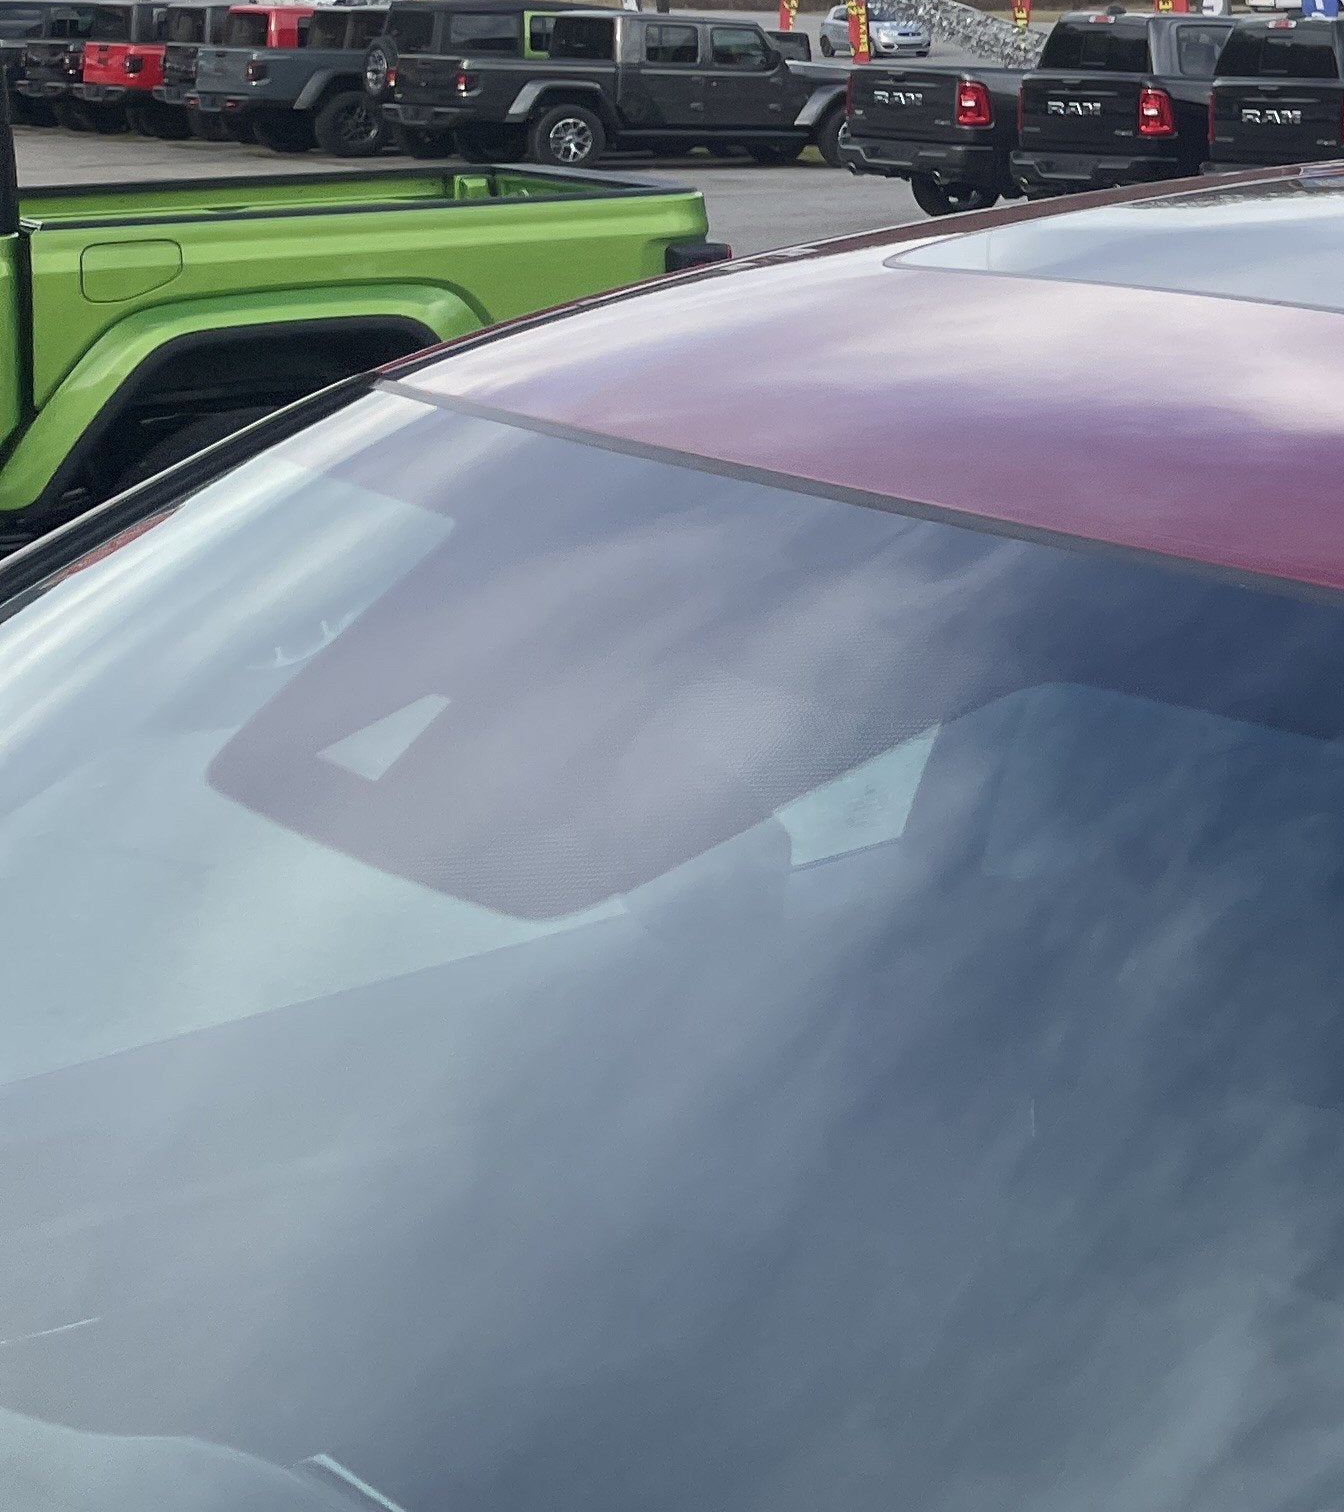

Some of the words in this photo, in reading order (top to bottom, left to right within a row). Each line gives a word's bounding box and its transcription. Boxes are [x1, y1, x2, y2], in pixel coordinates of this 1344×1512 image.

[873, 90, 924, 107] RAM
[1047, 100, 1101, 118] RAM
[1241, 108, 1303, 126] RAM
